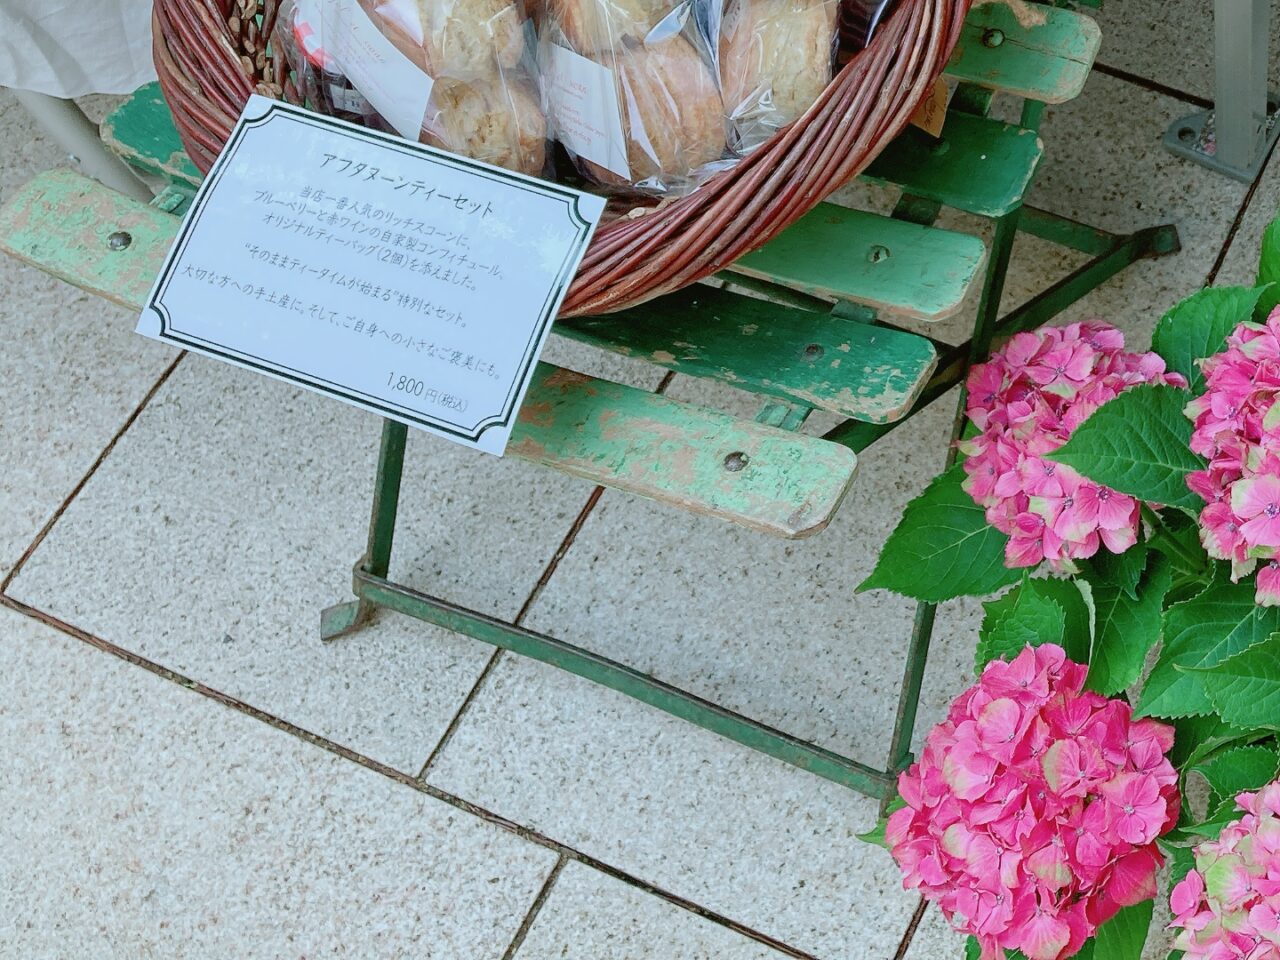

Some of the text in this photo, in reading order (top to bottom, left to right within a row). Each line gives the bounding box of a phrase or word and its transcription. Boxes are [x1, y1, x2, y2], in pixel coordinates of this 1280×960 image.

[300, 185, 471, 250] 当店一番人気のリッチスコーンに、
[319, 153, 493, 217] アフタヌーンティーセット
[254, 190, 504, 279] ブルーベリーと赤ワインの自家製コンフィチュール、
[264, 212, 477, 291] オリジナルティーバッグ(2個)を添えました。
[183, 264, 500, 380] 大切な方への手土産に。そして、ご自身への小さなご褒美にも。
